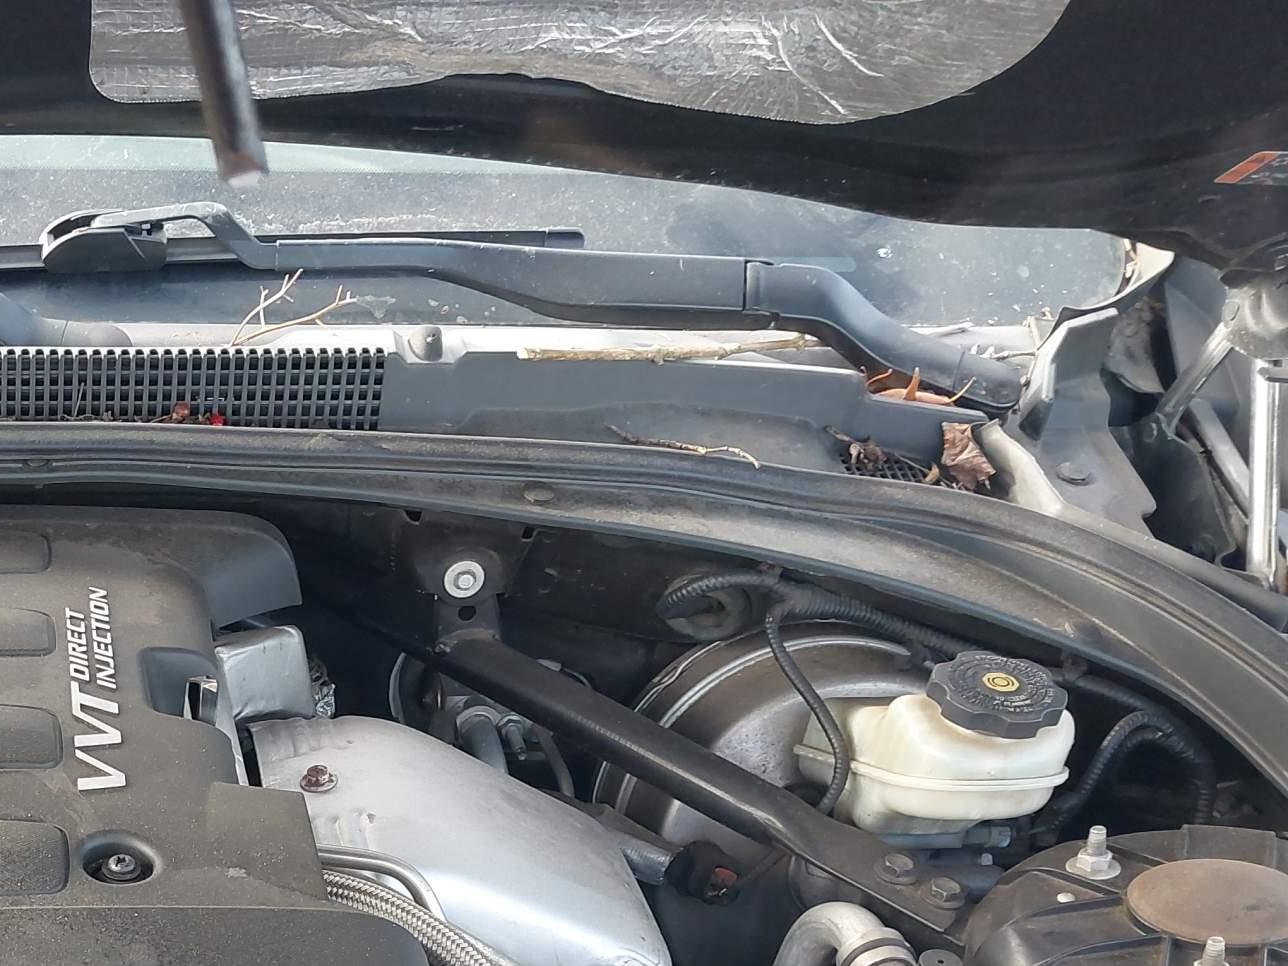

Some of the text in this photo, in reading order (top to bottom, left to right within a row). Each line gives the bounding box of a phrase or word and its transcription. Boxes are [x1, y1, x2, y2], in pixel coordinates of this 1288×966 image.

[65, 607, 90, 682] DIRECT
[88, 586, 117, 690] INJECTION
[70, 680, 127, 792] VVT
